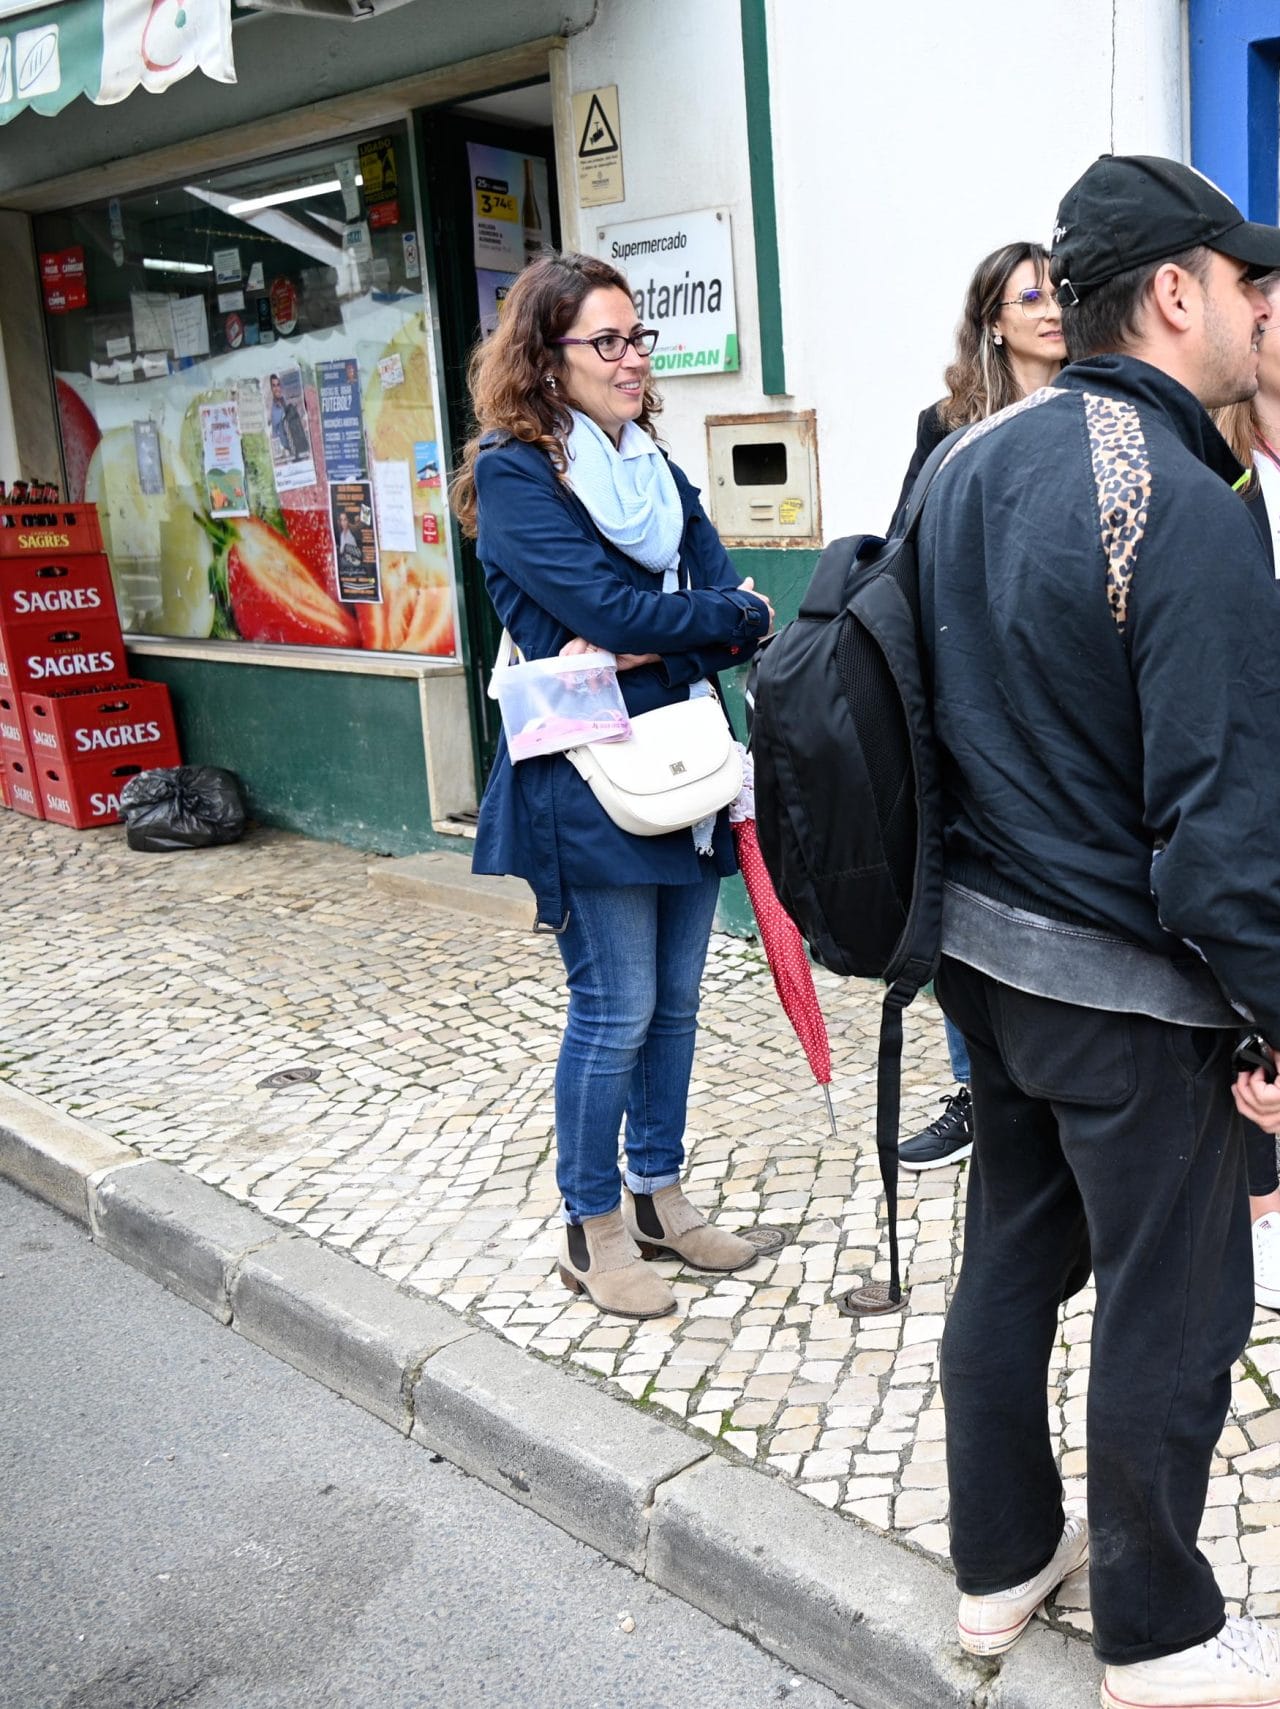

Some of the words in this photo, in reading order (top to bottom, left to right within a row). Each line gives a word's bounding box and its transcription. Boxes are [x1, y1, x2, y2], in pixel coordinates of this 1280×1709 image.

[611, 231, 687, 260] Supermercado
[633, 271, 722, 320] atarina
[18, 533, 70, 549] SAGRES
[14, 587, 101, 614] SAGRES
[28, 651, 115, 679] SAGRES
[75, 721, 161, 752] SAGRES
